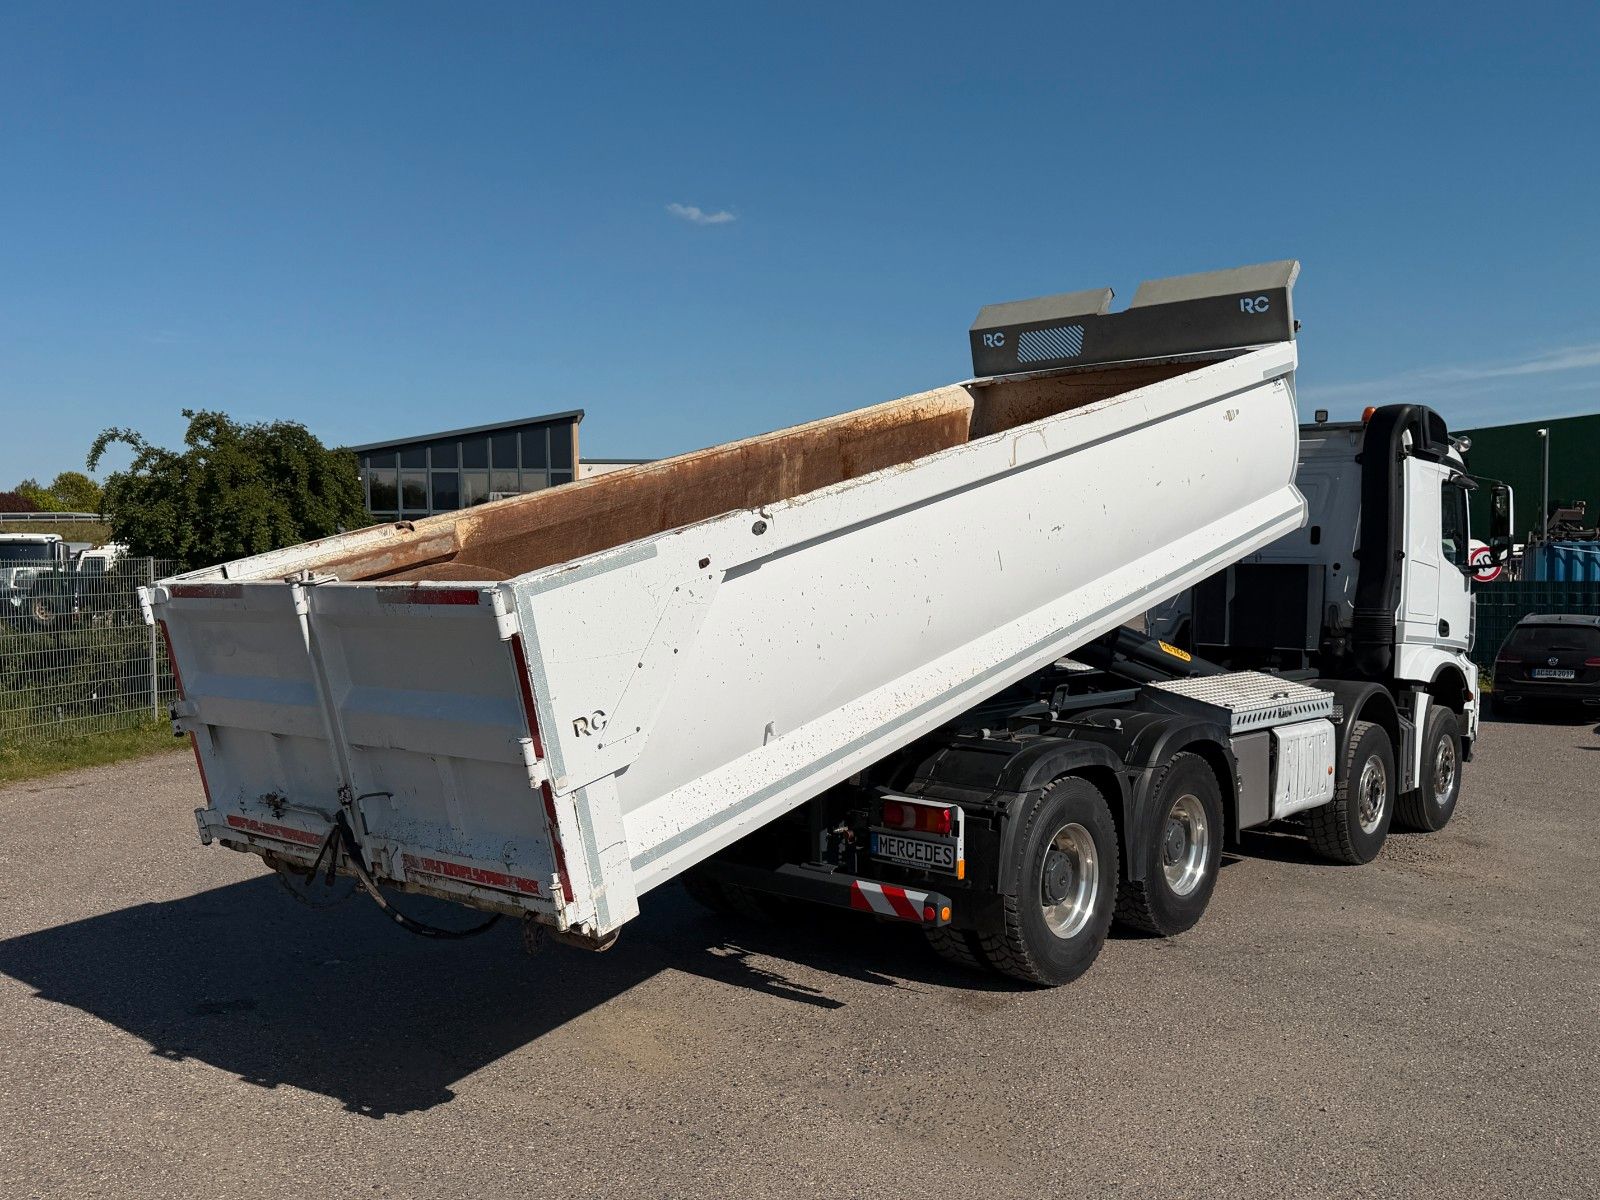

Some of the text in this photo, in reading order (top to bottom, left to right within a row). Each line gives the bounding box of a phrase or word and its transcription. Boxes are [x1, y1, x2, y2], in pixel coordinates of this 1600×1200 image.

[1240, 296, 1270, 314] RC
[983, 332, 1006, 348] RC
[879, 836, 952, 866] MERCEDES
